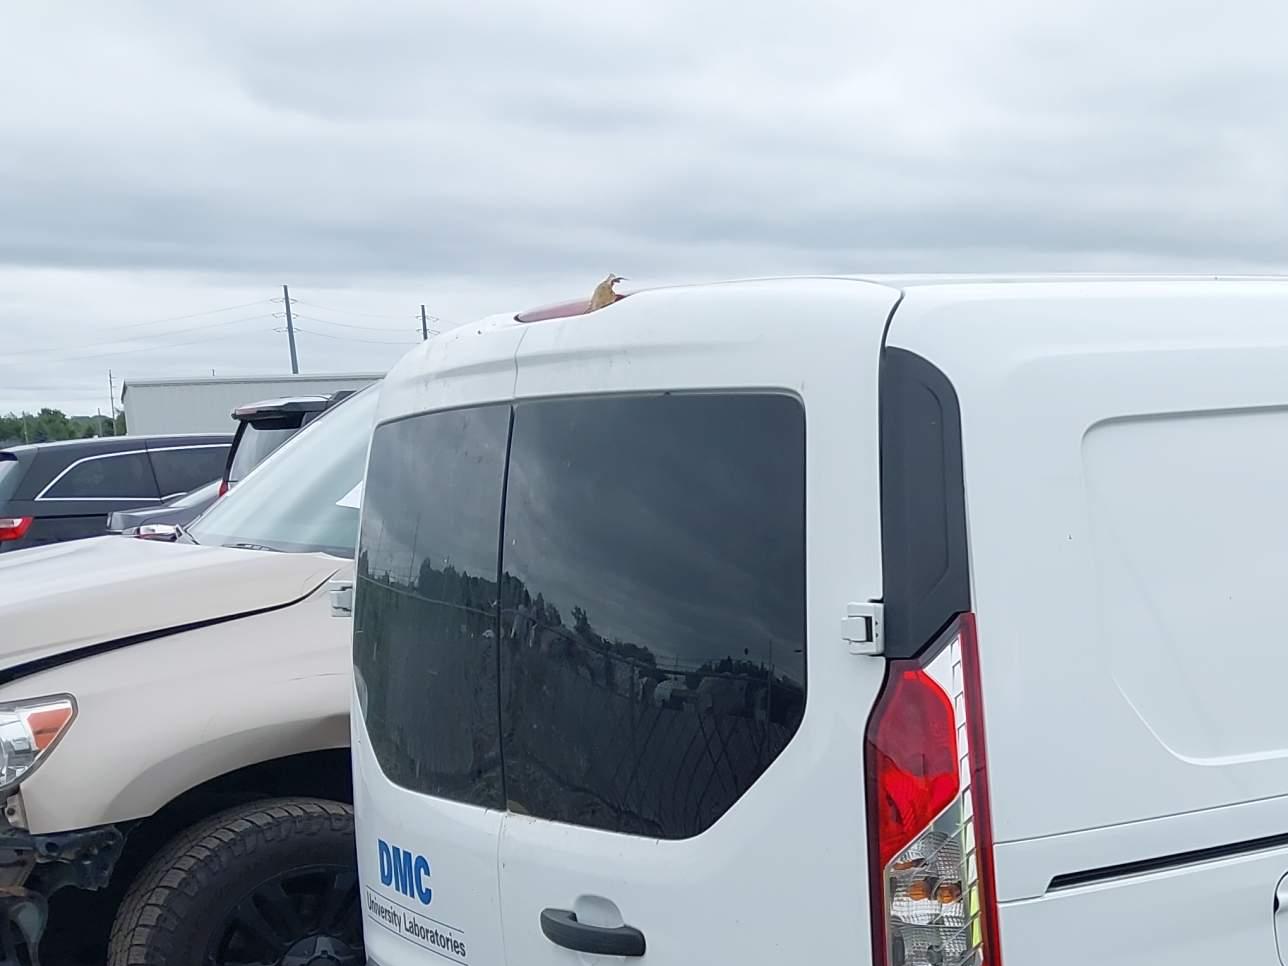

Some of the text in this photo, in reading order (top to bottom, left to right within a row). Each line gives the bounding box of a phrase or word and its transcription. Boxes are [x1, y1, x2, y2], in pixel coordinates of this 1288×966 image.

[377, 838, 432, 906] DMC
[366, 890, 467, 958] University Laboratories
